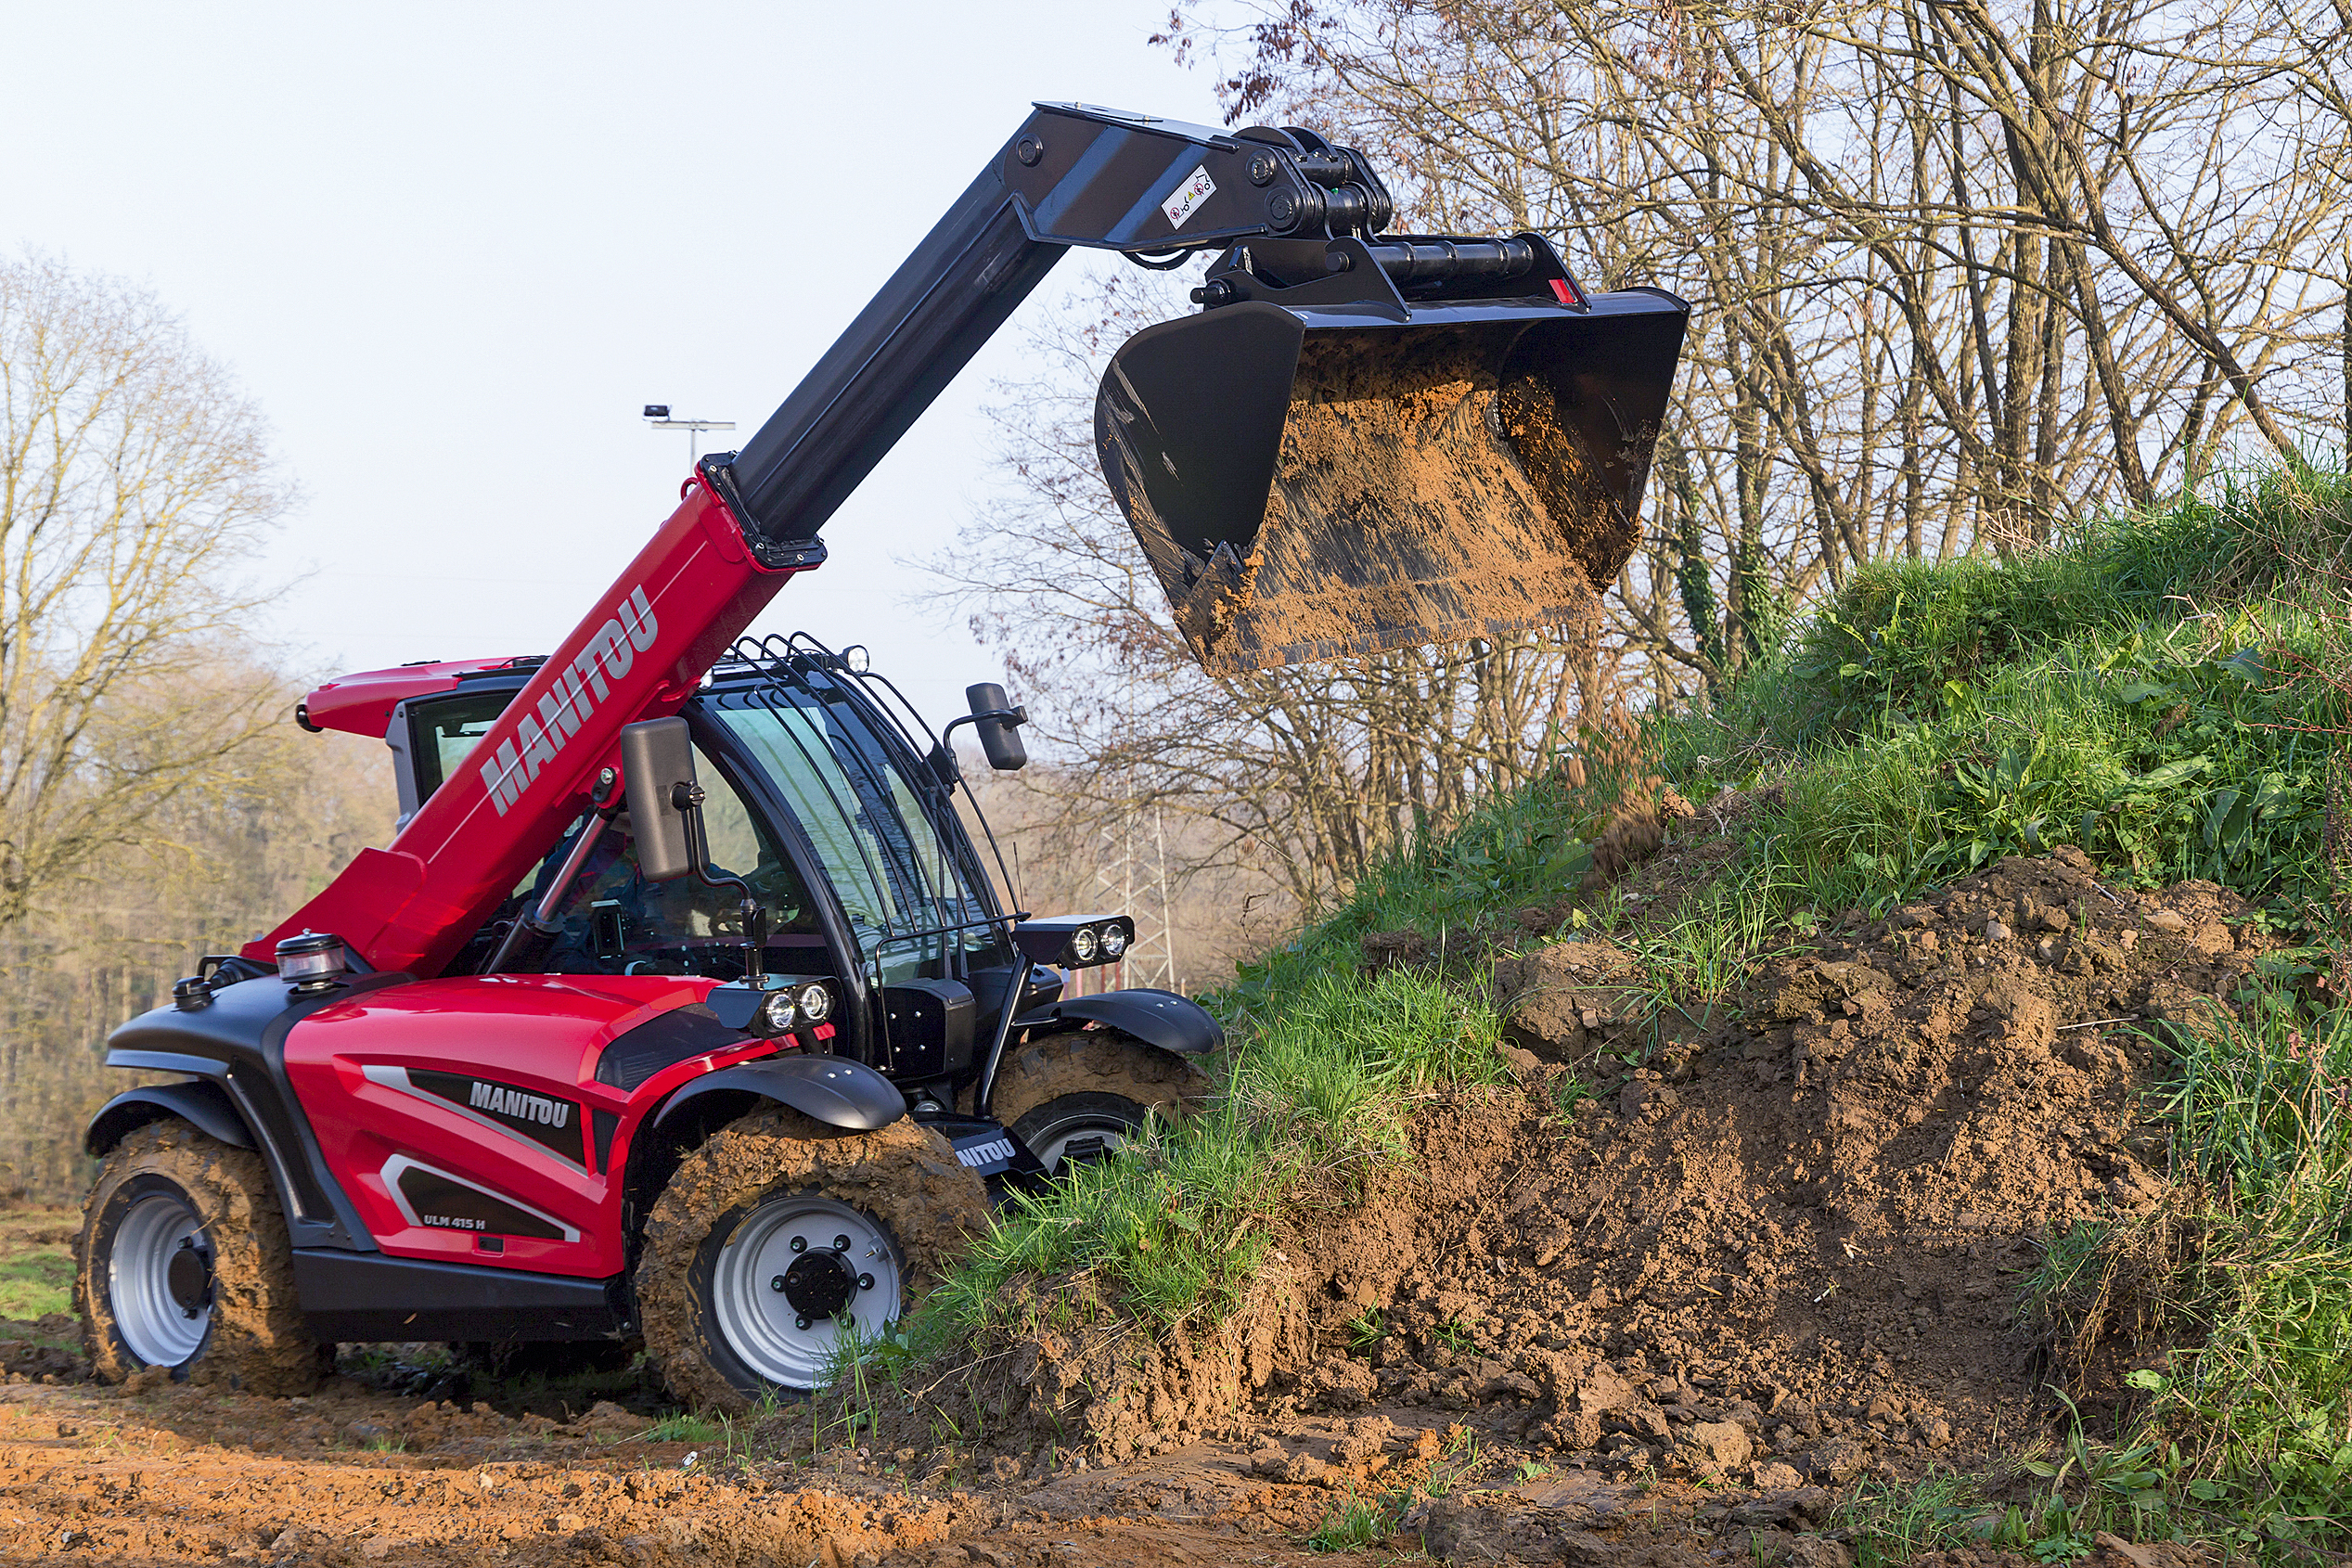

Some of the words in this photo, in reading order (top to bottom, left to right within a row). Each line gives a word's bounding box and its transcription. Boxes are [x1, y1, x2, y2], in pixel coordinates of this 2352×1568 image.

[479, 584, 658, 817] MANITOU
[469, 1081, 570, 1128] MANITOU
[956, 1137, 1016, 1167] NITOU
[423, 1215, 450, 1227] ULM
[451, 1217, 474, 1229] 415
[475, 1219, 486, 1230] H
